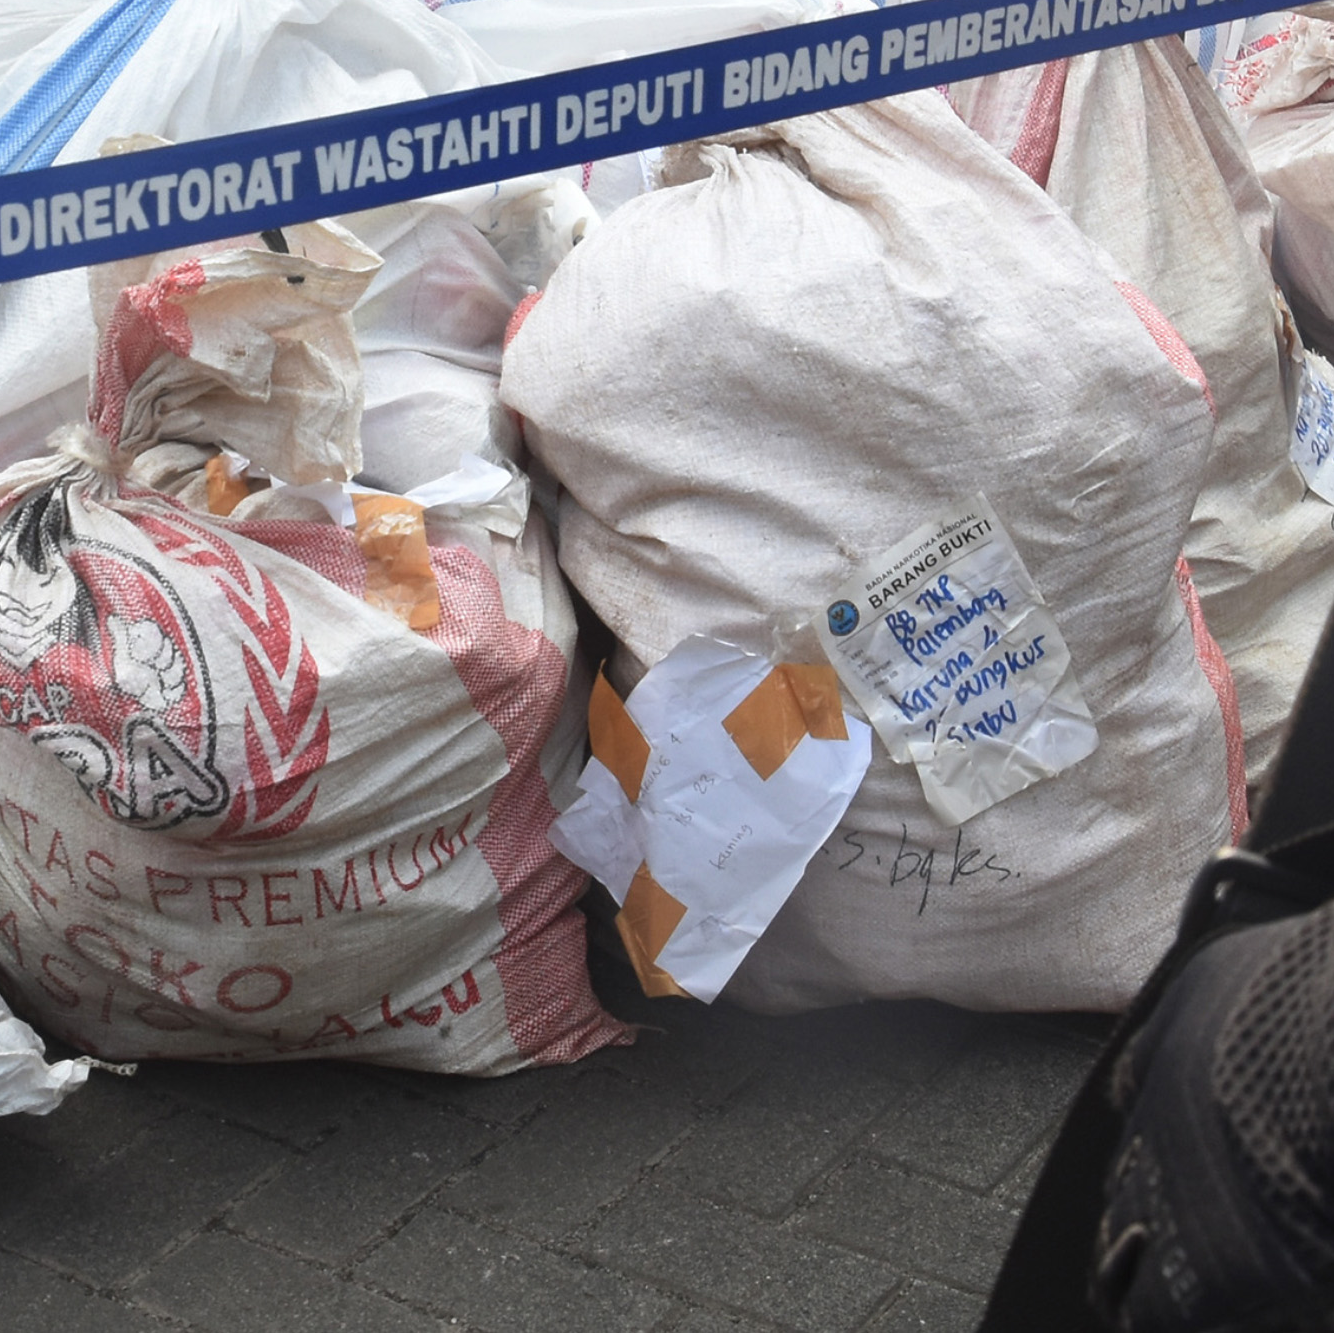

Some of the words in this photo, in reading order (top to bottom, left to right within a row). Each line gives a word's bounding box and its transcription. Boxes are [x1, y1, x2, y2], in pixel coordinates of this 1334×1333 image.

[0, 150, 302, 257] DIREKTORAT
[314, 100, 542, 196] WASTAHTI
[556, 66, 704, 146] DEPUTI
[722, 34, 870, 111] BIDANG
[864, 568, 896, 592] BADAN
[893, 537, 937, 574] NARKOTIKA
[934, 512, 978, 545] NASIONAL
[868, 555, 938, 610] BARANG
[938, 518, 993, 559] BUKTI
[884, 609, 917, 645] BB
[901, 586, 1008, 667] Palembang
[145, 808, 475, 928] PREMIUM
